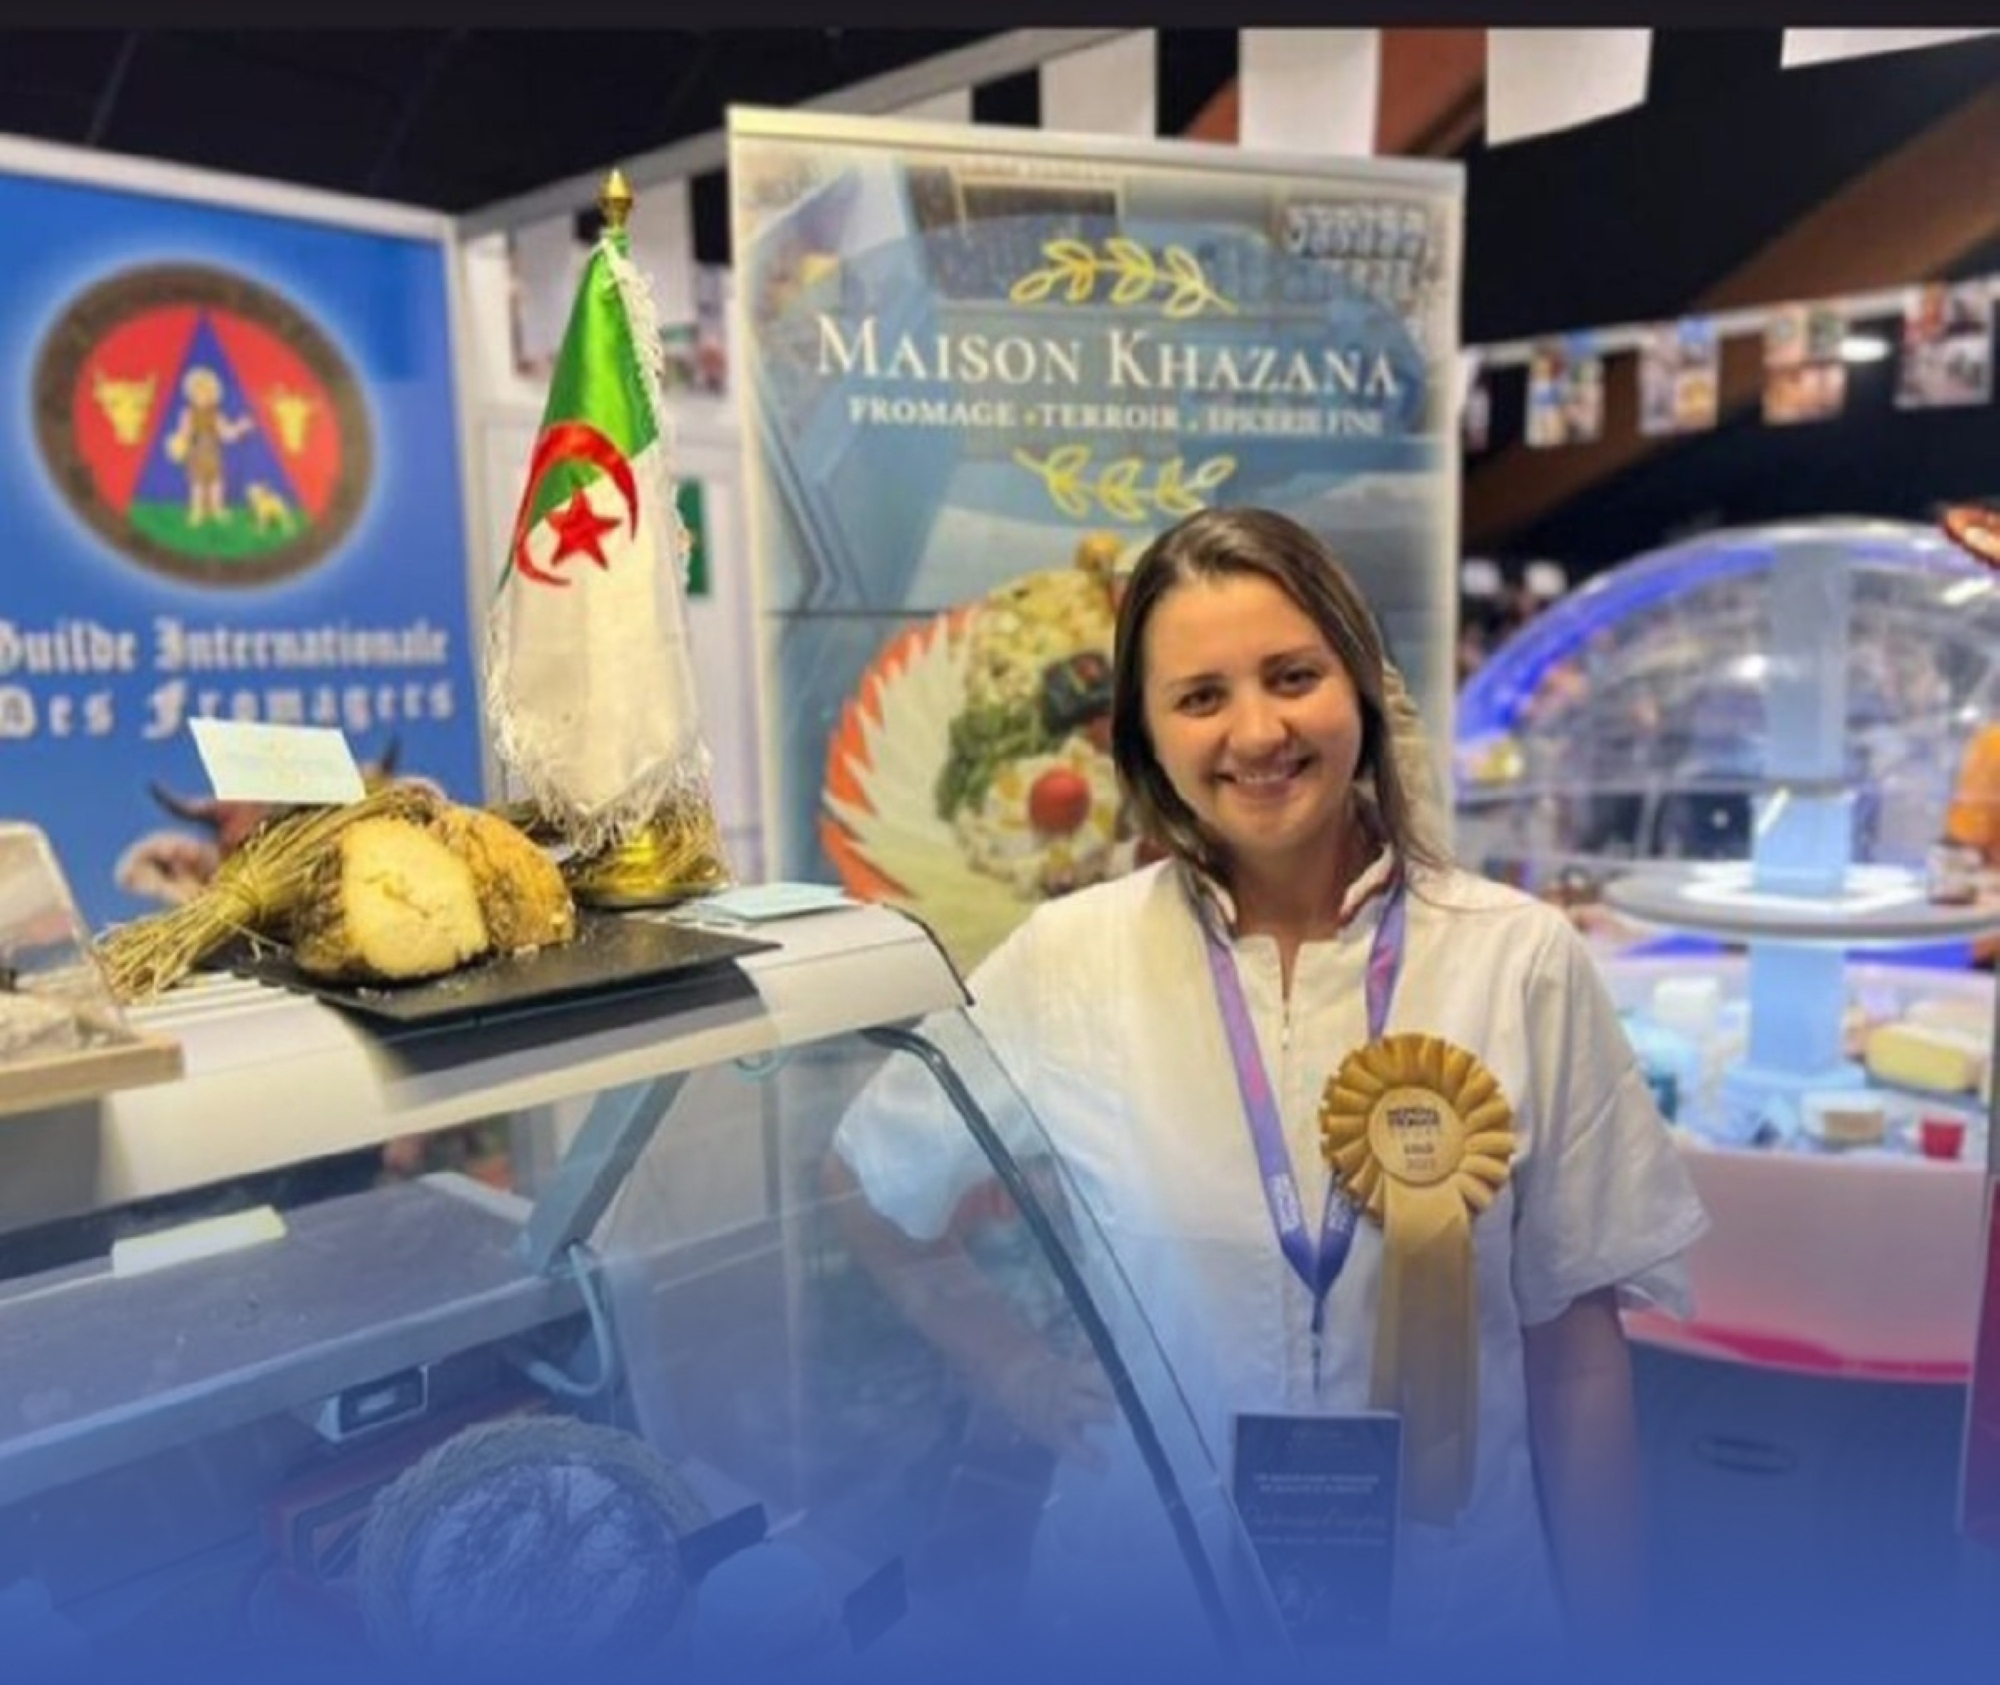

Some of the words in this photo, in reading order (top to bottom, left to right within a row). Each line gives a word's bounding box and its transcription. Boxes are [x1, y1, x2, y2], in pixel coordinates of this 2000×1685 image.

[849, 395, 1017, 428] FROMAGE
[1040, 402, 1178, 432] TERROIR
[153, 615, 449, 672] Internationale
